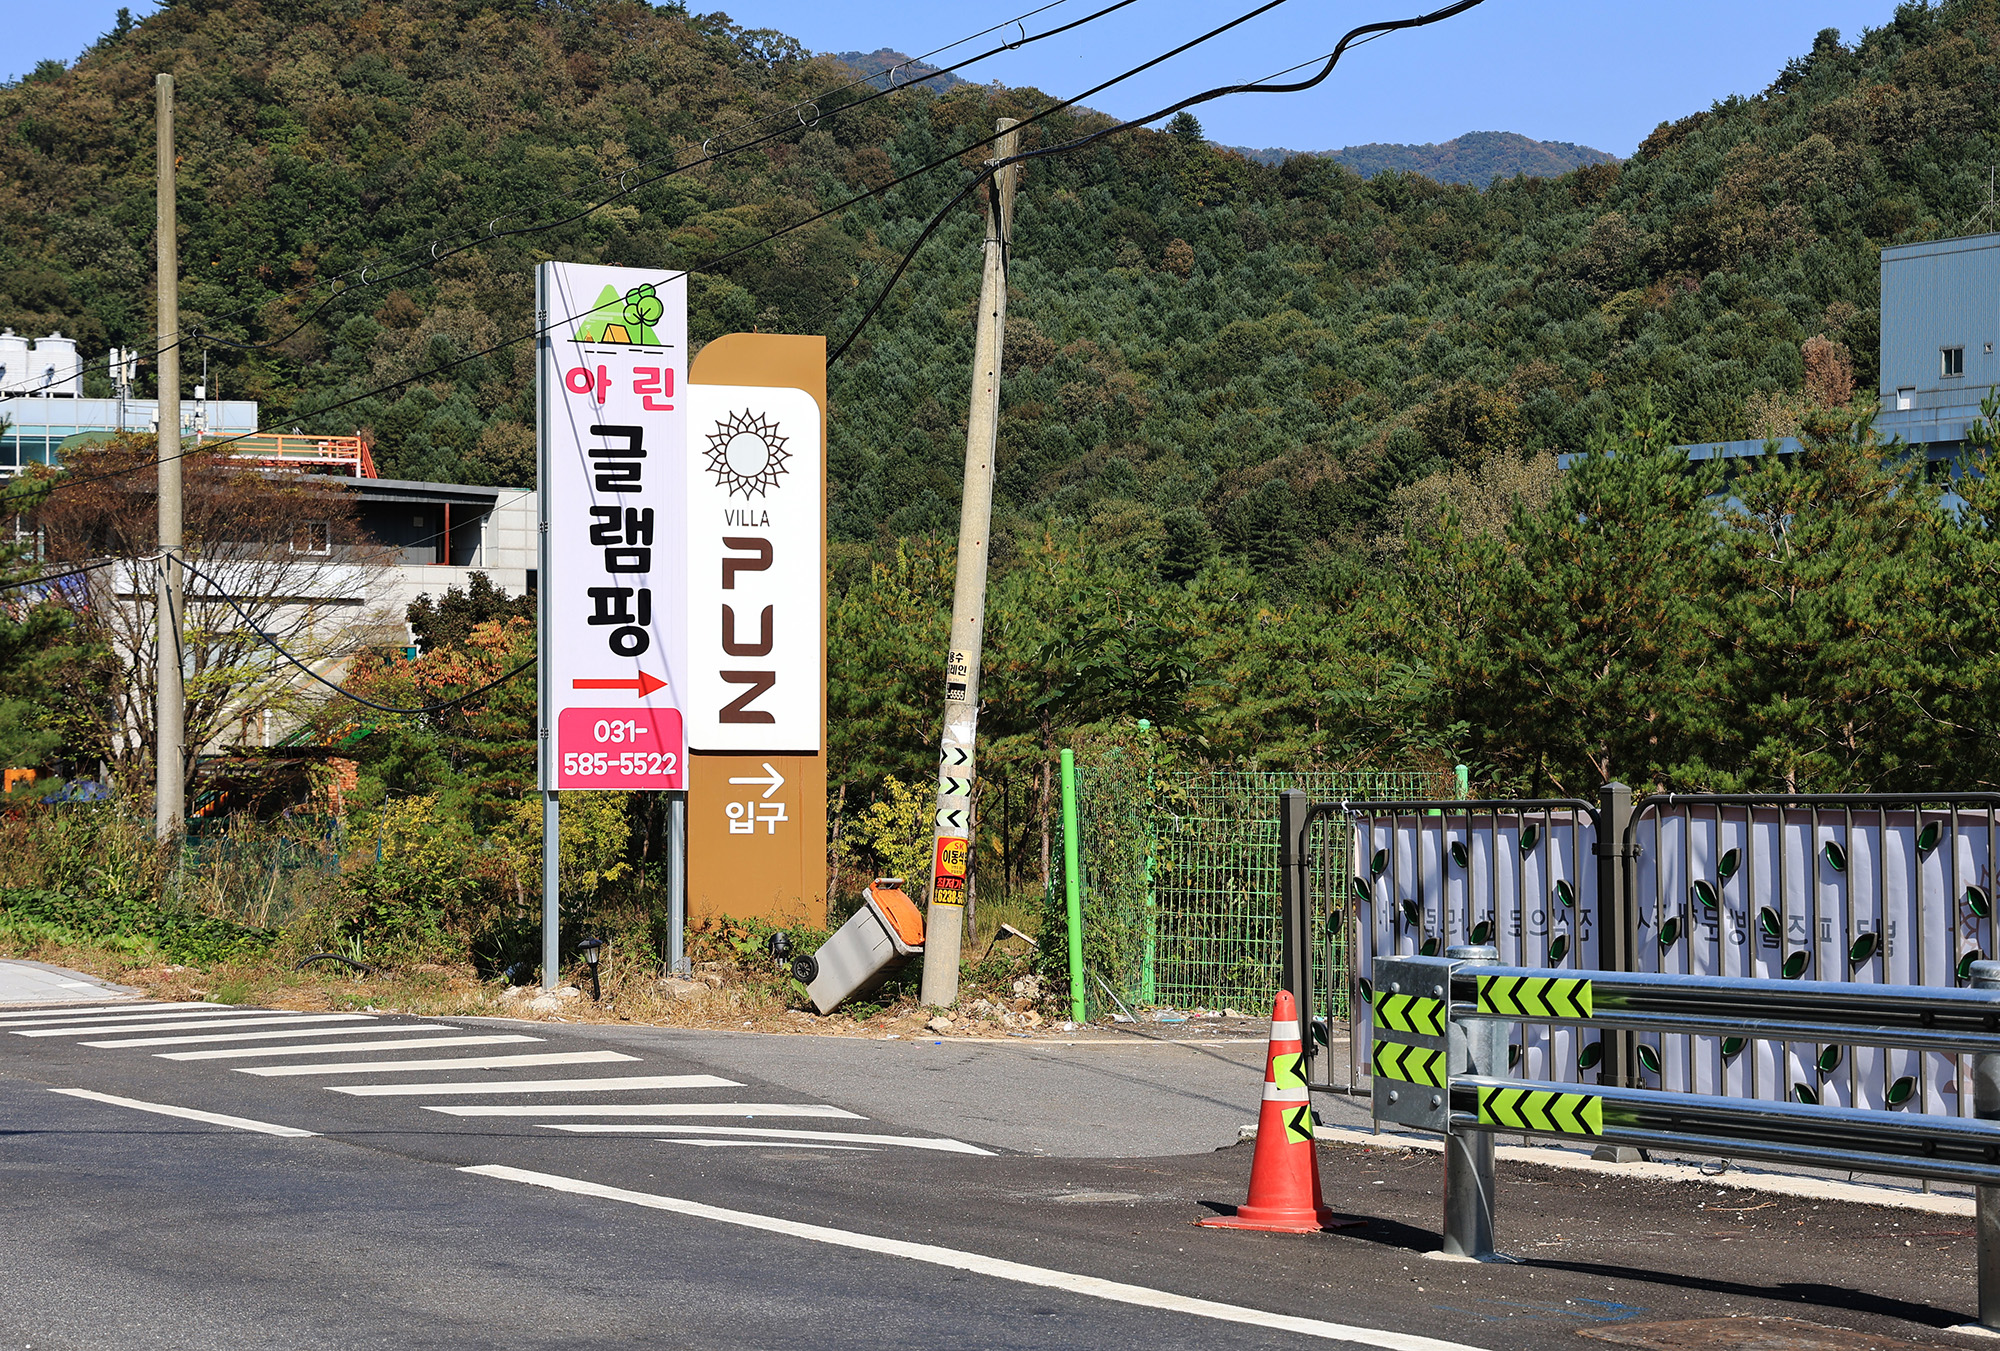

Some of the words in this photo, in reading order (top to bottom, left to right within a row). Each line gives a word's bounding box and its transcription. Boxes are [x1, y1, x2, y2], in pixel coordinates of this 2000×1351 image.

[724, 508, 770, 528] VILLA
[586, 424, 655, 658] 글램핑
[947, 664, 968, 677] 레인
[593, 719, 649, 744] 031-
[563, 752, 677, 777] 585-5522
[725, 800, 789, 835] 입구
[954, 842, 964, 851] SK
